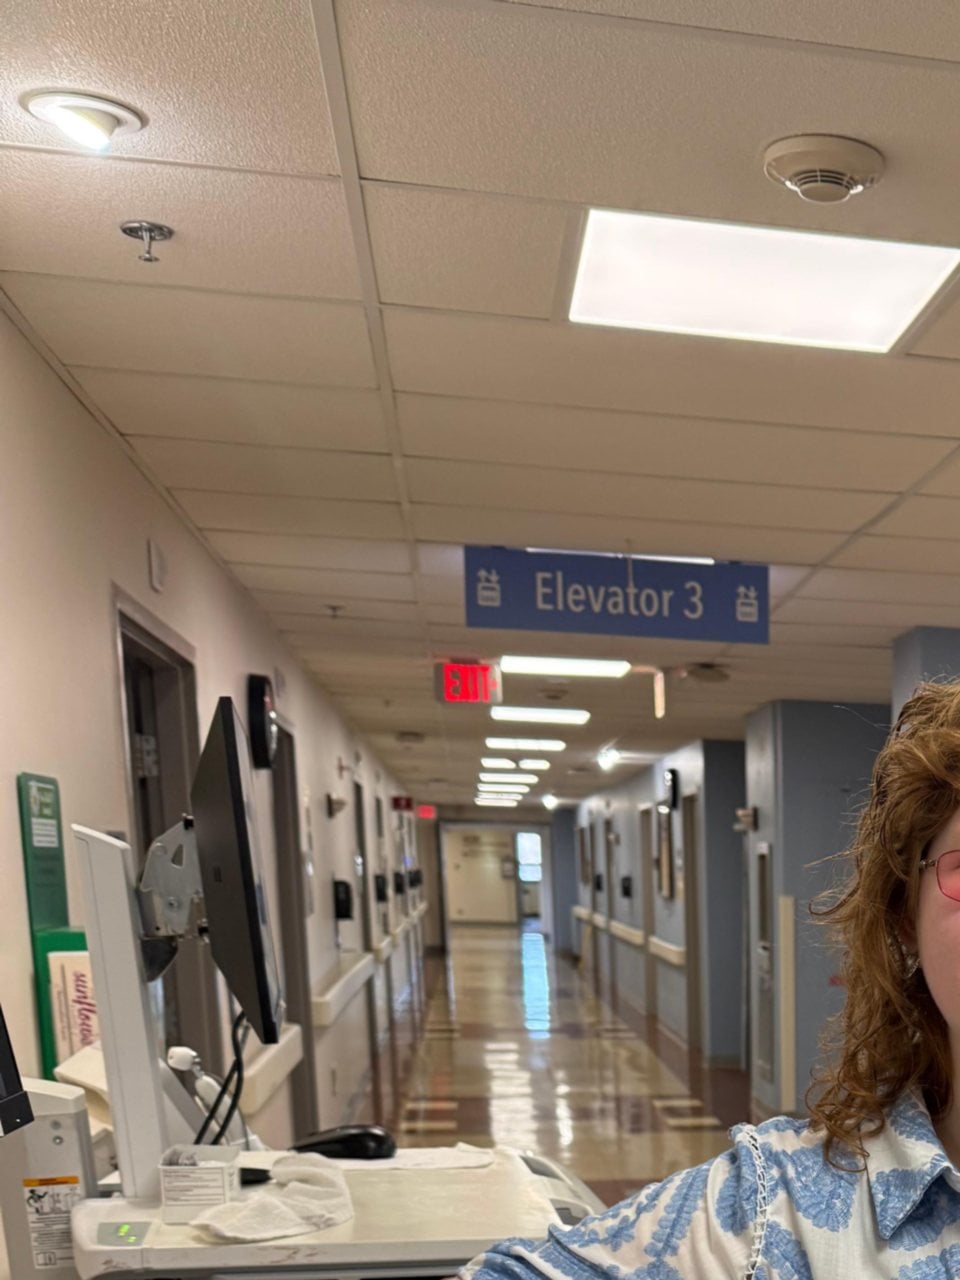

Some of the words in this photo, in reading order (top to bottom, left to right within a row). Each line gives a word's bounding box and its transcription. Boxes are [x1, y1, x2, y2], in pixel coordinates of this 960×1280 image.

[535, 571, 674, 618] Elevator
[683, 581, 704, 619] 3
[443, 663, 491, 703] EXIT
